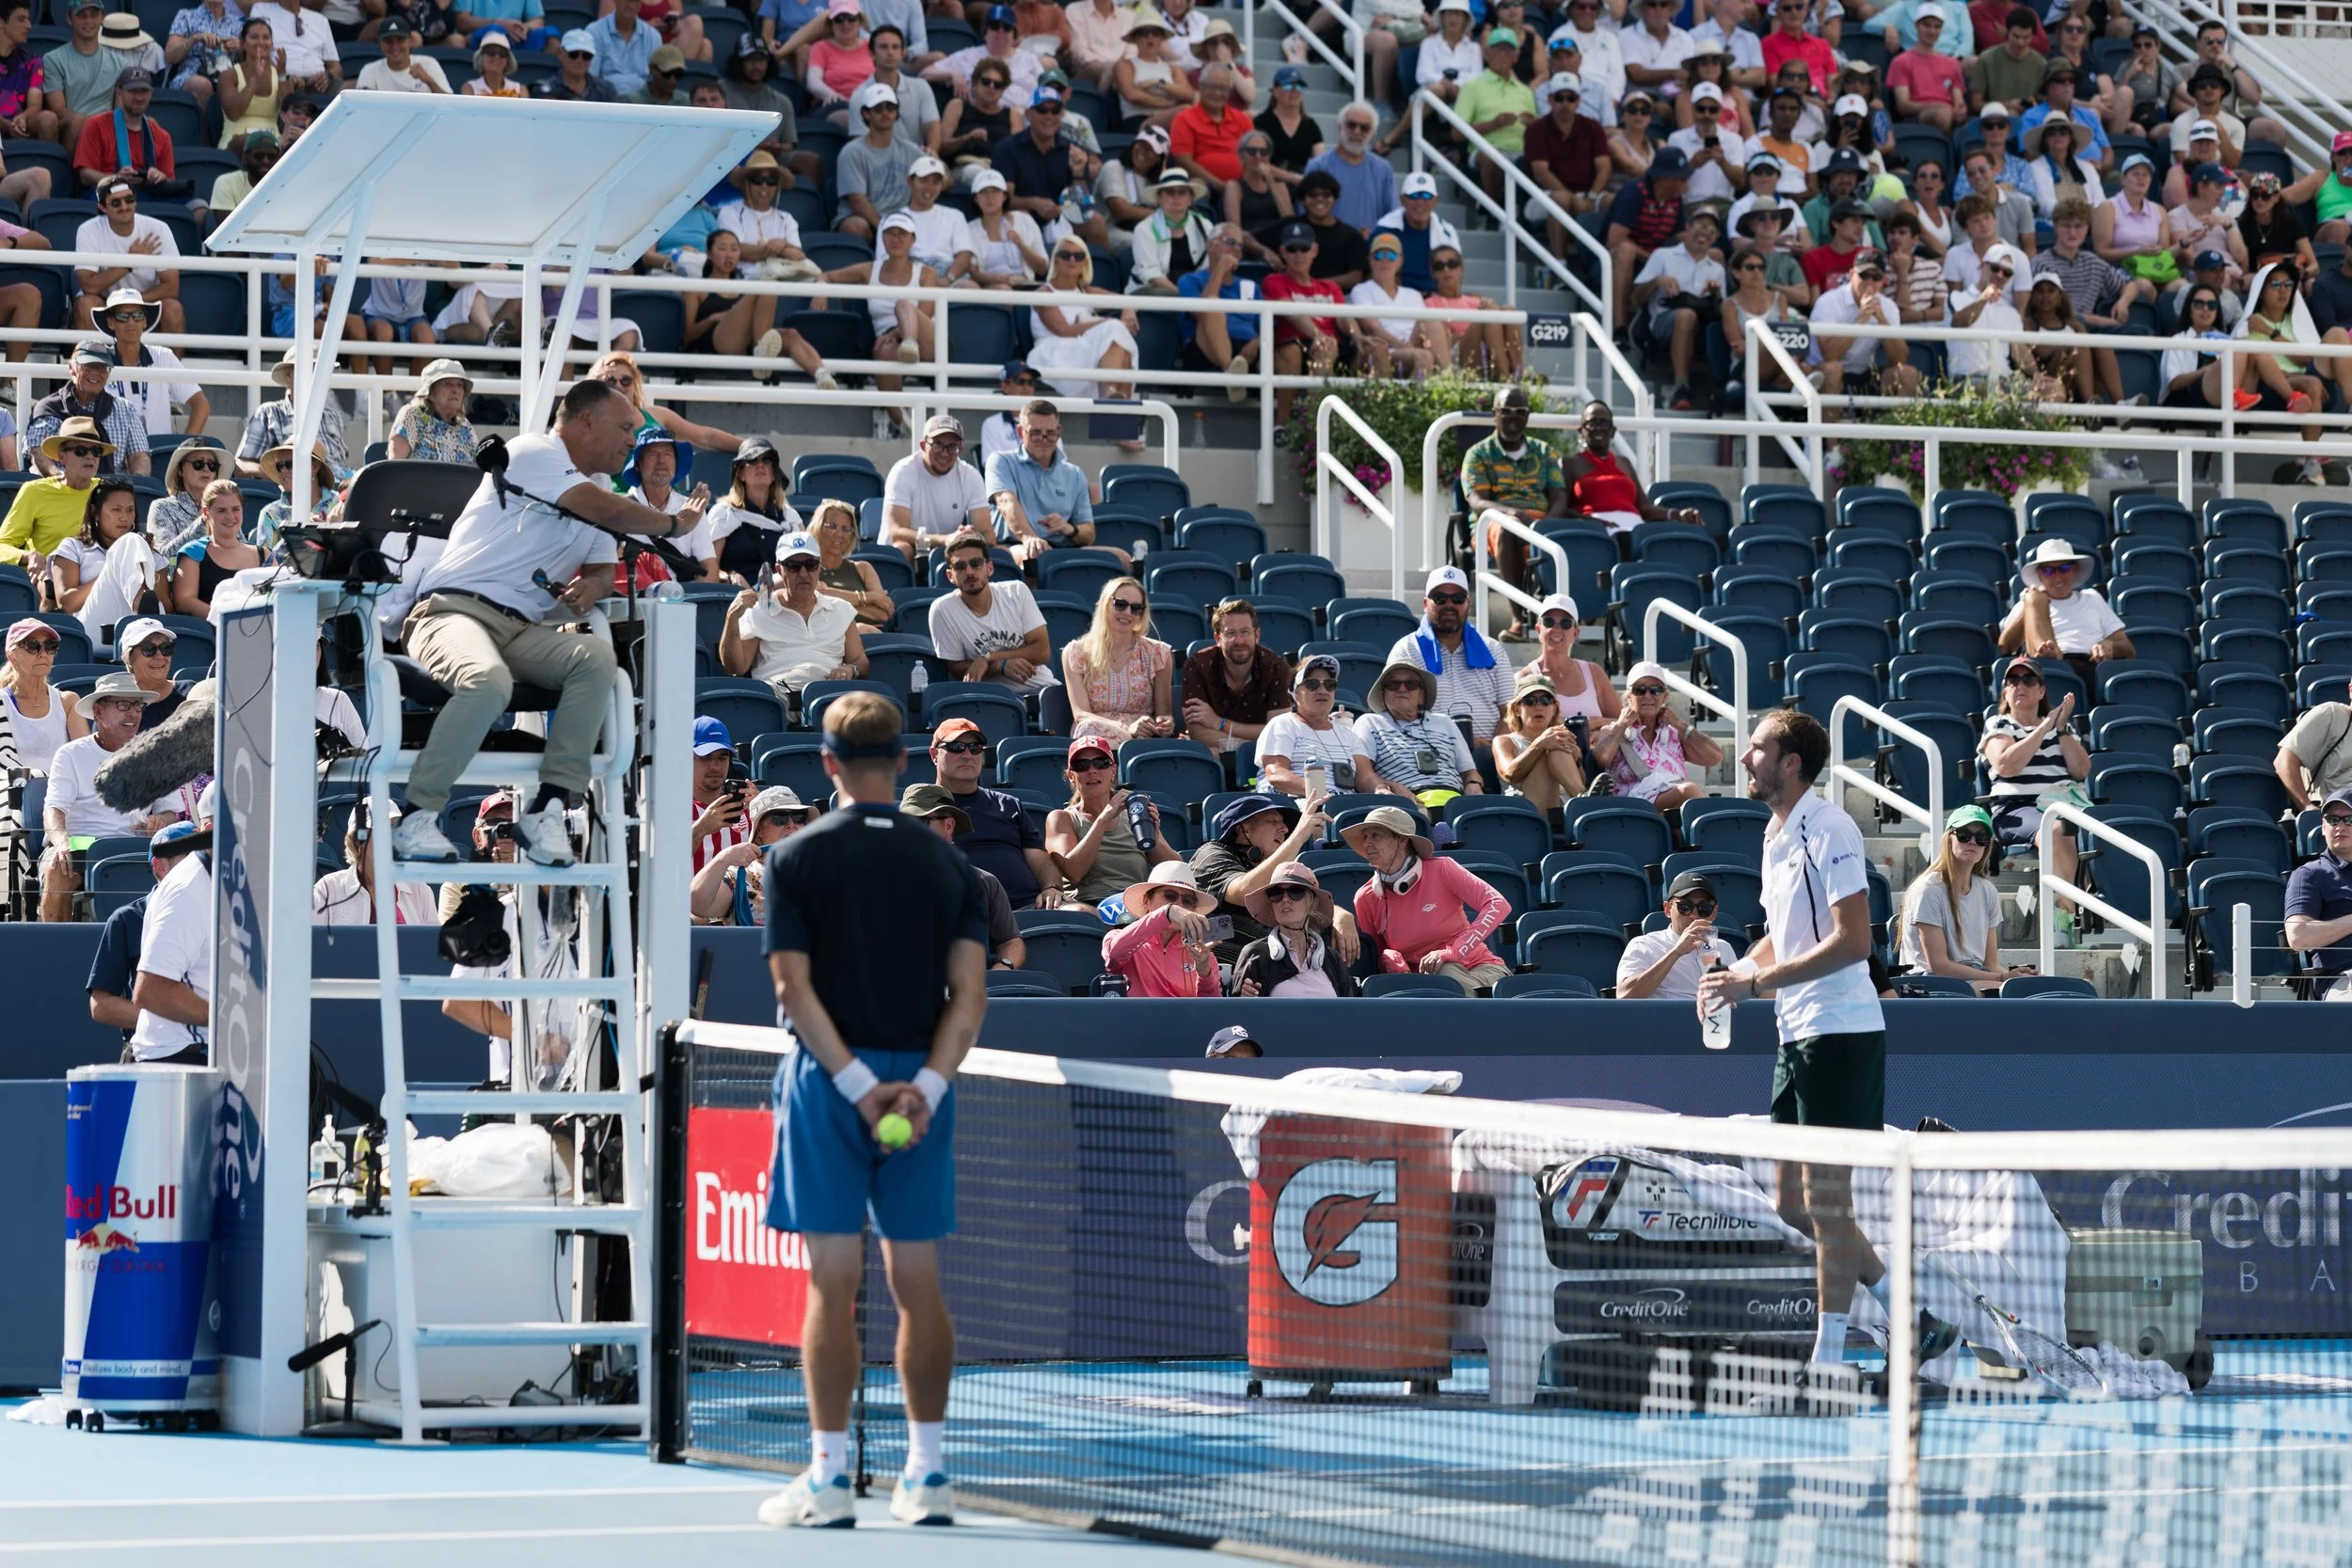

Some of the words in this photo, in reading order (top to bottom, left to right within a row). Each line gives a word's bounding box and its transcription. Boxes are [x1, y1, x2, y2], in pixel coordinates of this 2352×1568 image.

[1531, 325, 1569, 341] G219
[973, 629, 1027, 656] NCINNAT
[1077, 736, 1099, 748] 25
[224, 746, 253, 1201] CreditOne
[109, 1185, 176, 1220] Bull
[2102, 1166, 2352, 1249] Credi
[1273, 1158, 1398, 1307] G
[114, 1260, 165, 1273] DRINK
[1600, 1300, 1689, 1318] CreditOne
[1747, 1298, 1818, 1316] CreditOn
[115, 1362, 136, 1377] body
[139, 1362, 158, 1372] and
